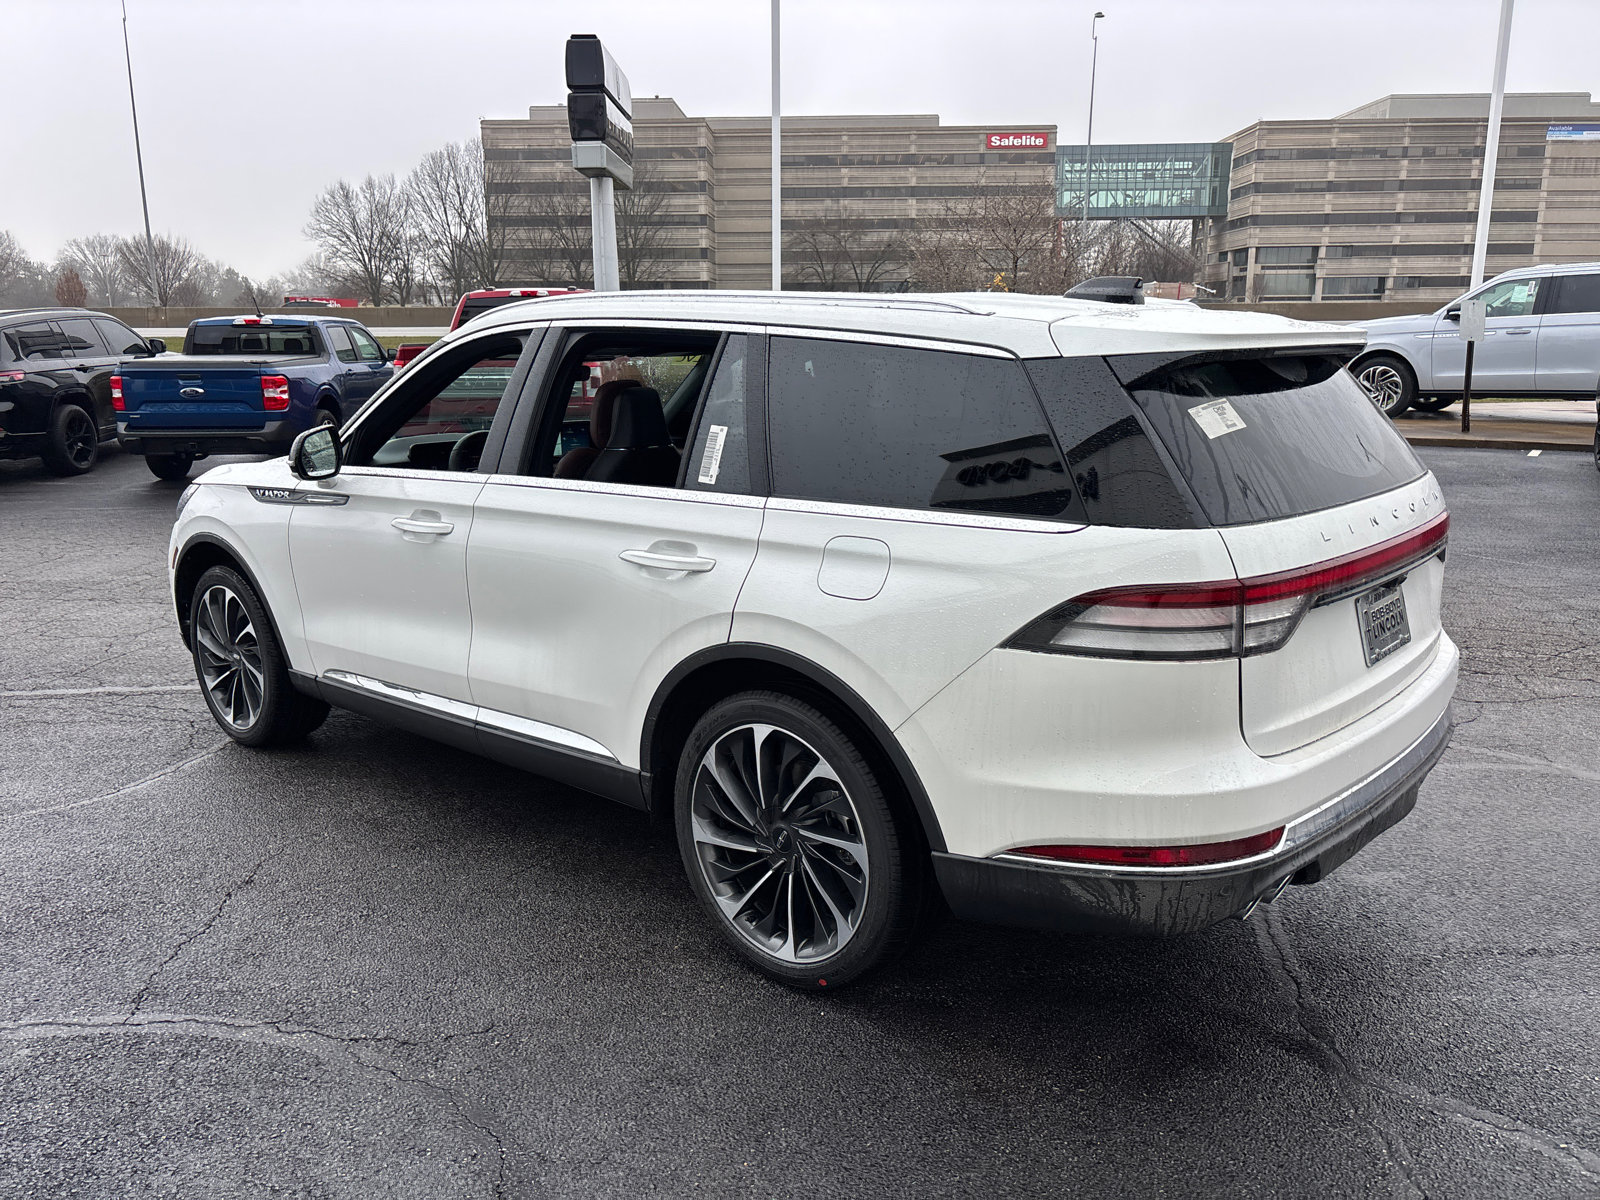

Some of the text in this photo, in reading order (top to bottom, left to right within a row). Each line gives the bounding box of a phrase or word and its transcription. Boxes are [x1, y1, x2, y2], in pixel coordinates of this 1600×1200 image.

[990, 135, 1044, 146] Safelite
[255, 489, 290, 499] AVIATOR
[1320, 491, 1439, 542] LINCOLN
[1372, 608, 1405, 639] LINCOLN
